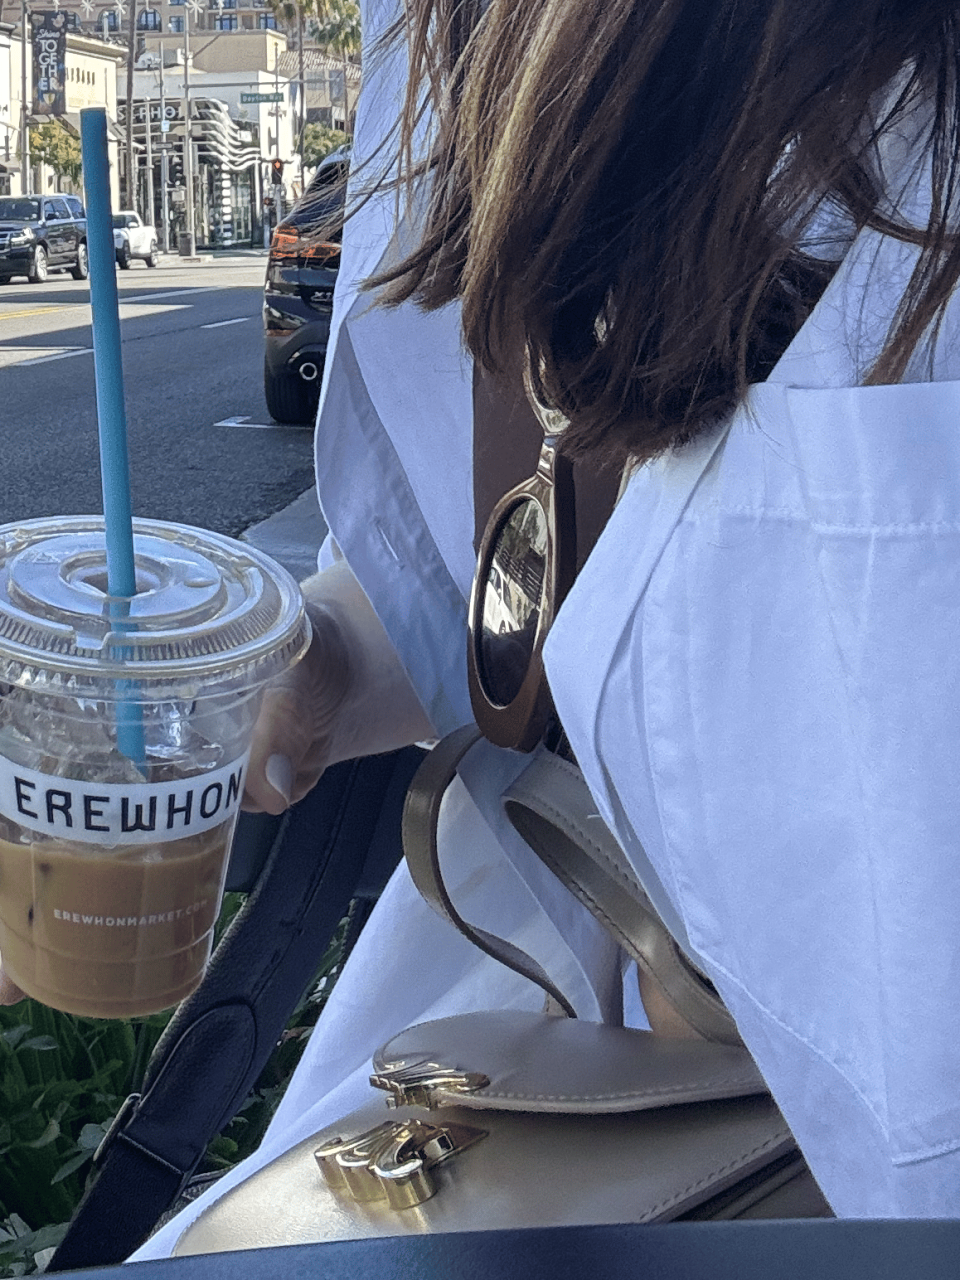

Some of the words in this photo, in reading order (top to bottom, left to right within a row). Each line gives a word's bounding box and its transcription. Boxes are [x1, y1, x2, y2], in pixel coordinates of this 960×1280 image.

[40, 39, 58, 53] TO
[38, 52, 58, 66] GE
[40, 65, 58, 78] TH
[14, 767, 242, 832] EREWHON
[53, 899, 208, 927] EREWHONMARKET.COM
